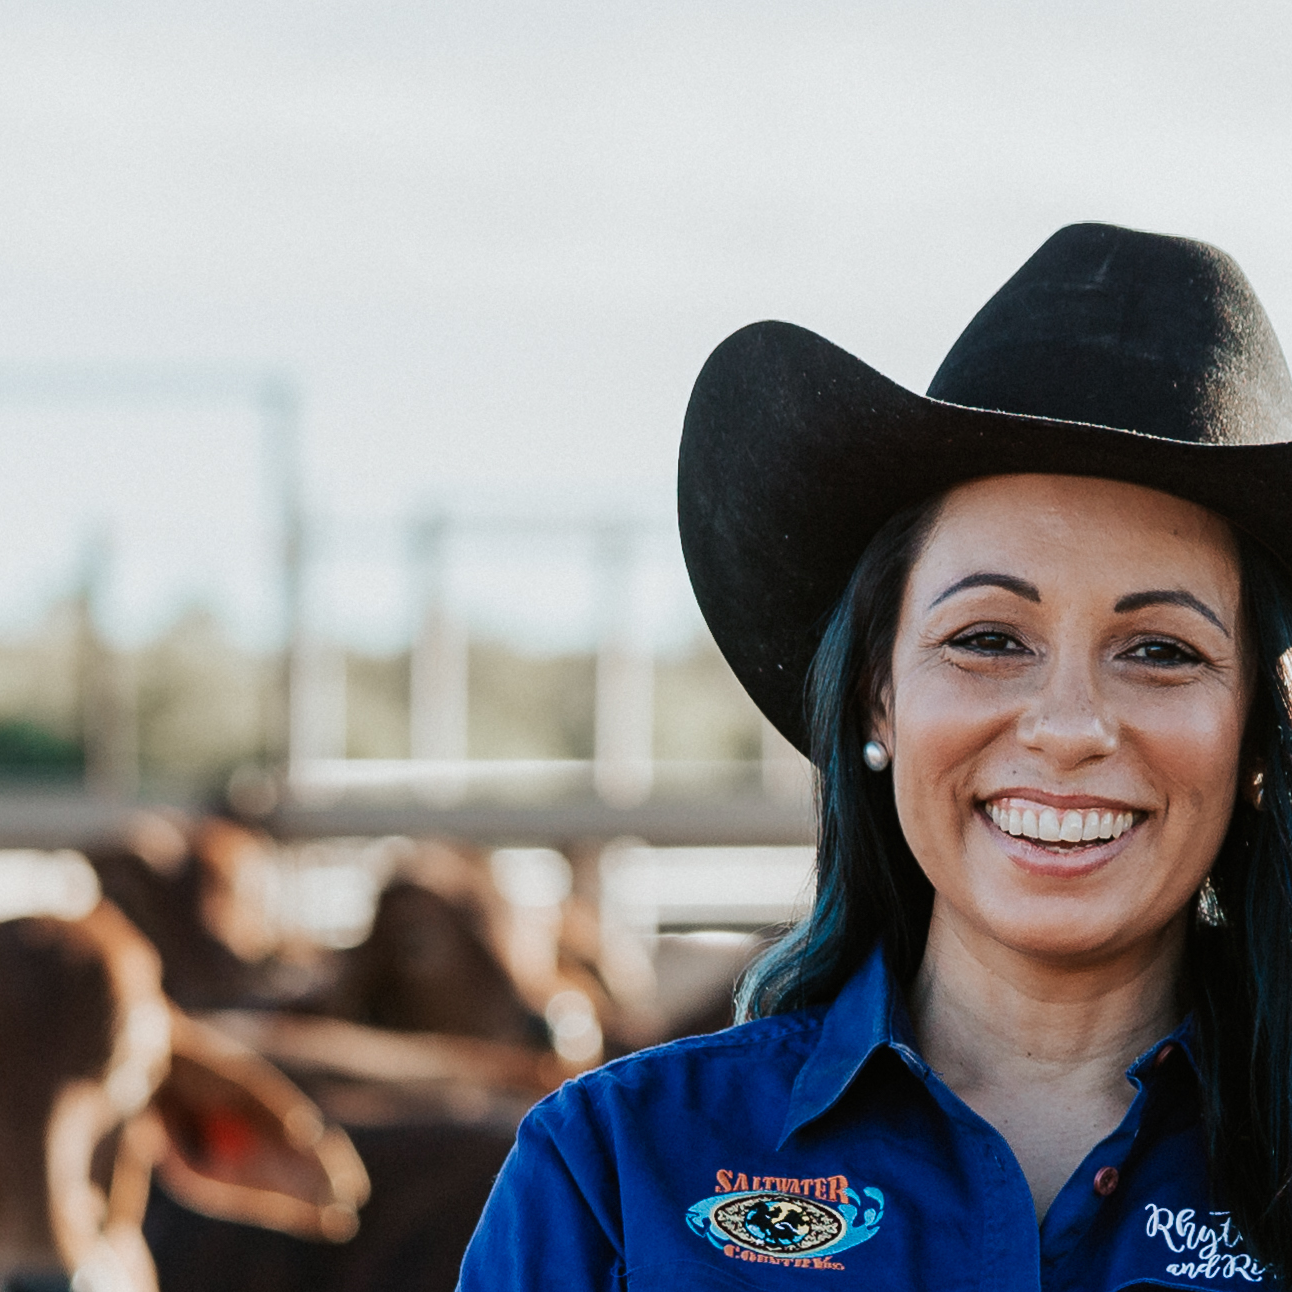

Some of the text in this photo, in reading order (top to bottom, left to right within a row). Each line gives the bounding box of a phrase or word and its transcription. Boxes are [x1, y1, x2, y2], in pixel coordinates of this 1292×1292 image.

[715, 1169, 850, 1204] SALTWATER
[1145, 1203, 1243, 1260] Rhyt
[1166, 1254, 1220, 1279] and
